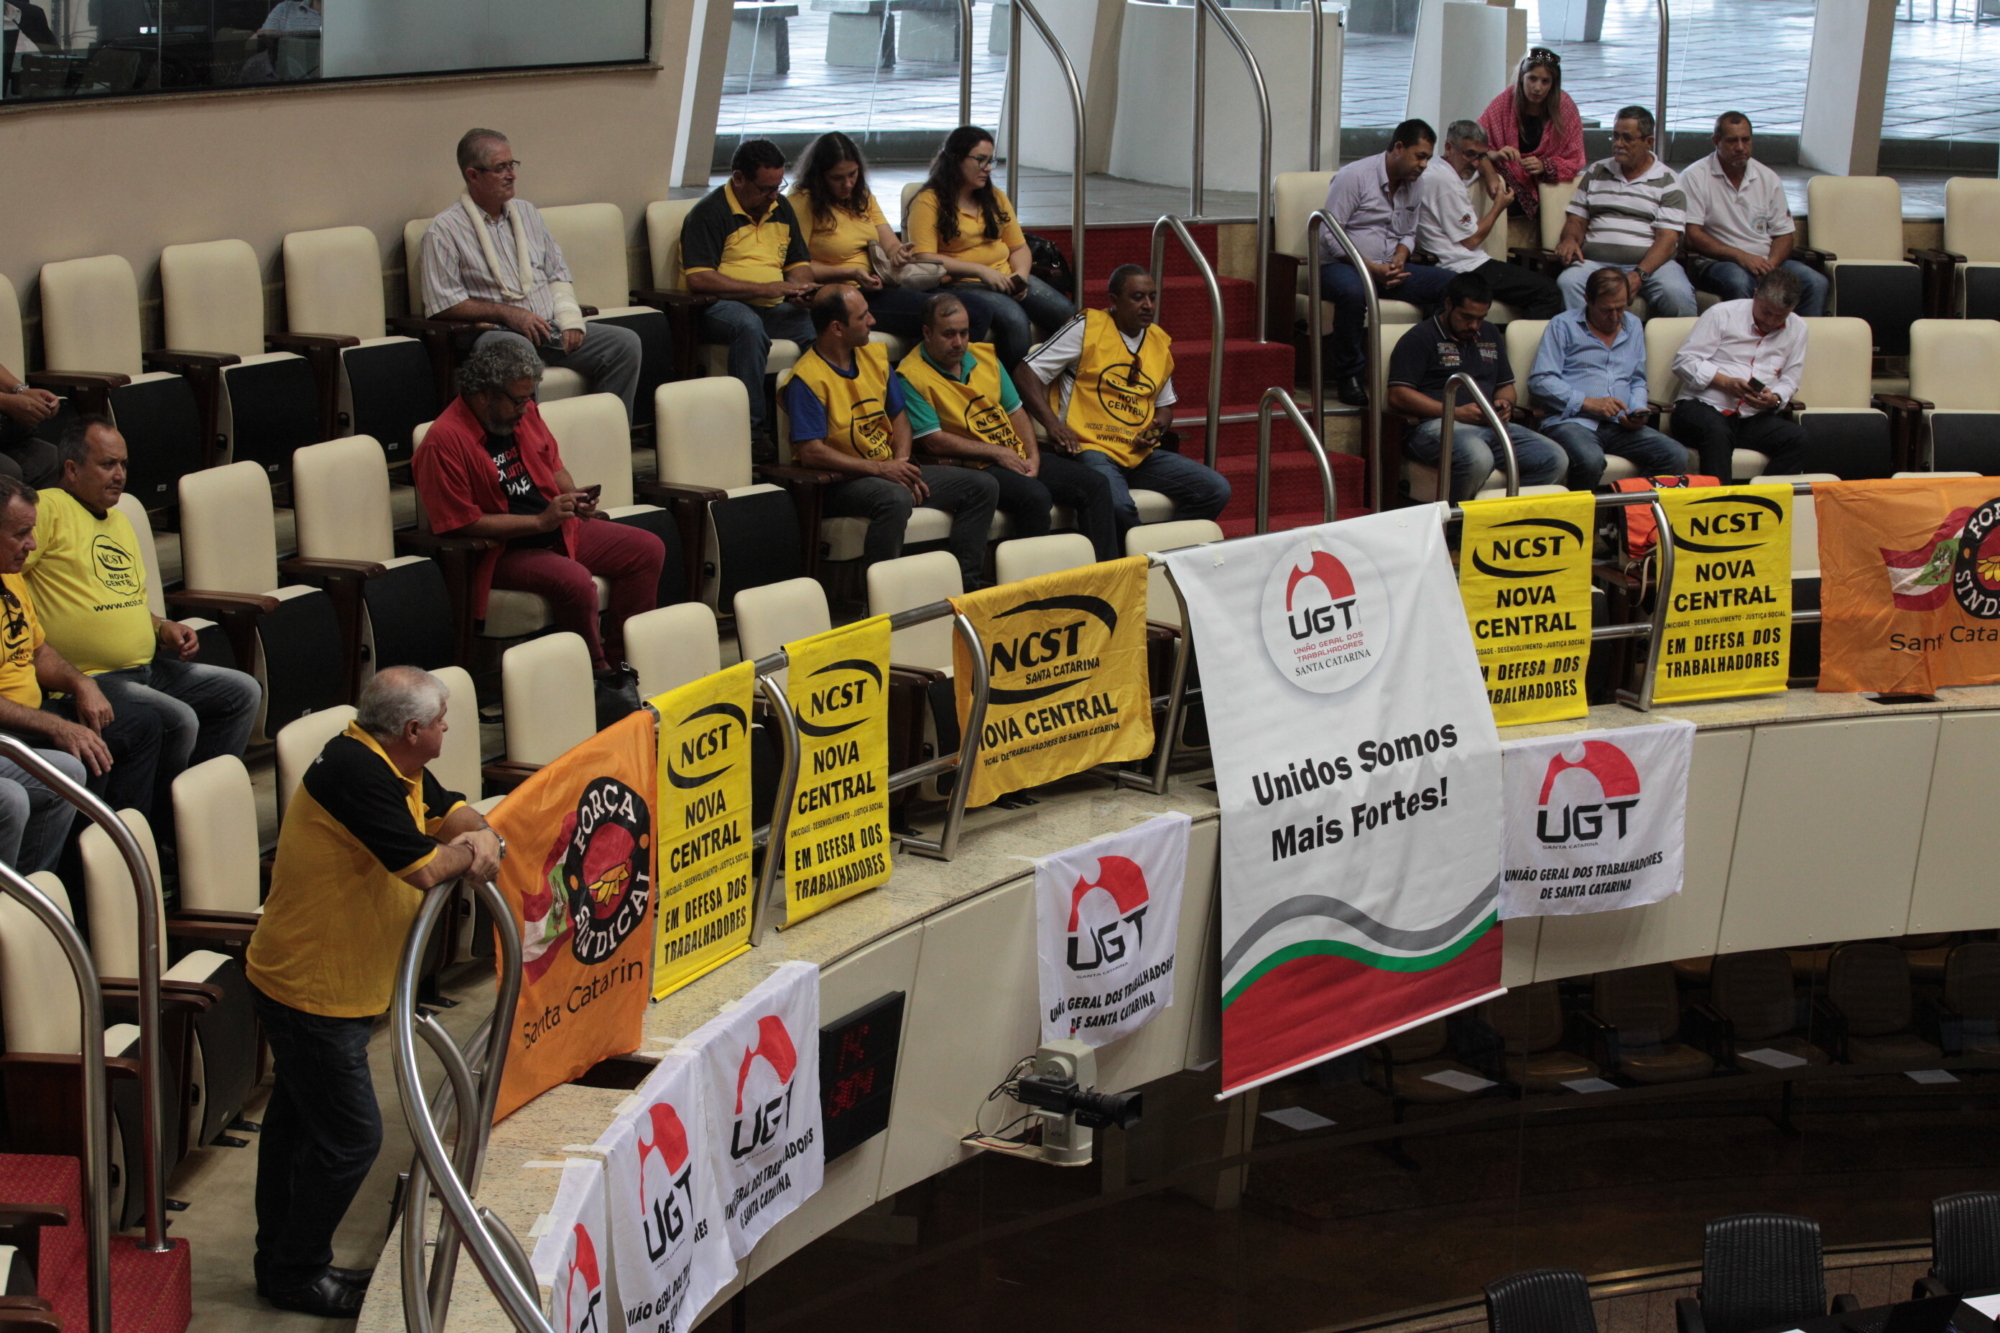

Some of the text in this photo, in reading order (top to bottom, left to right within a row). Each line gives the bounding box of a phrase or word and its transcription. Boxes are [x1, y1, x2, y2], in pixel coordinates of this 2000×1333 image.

[1107, 400, 1145, 418] CENTRAL
[1690, 511, 1764, 537] NCST
[1492, 535, 1566, 562] NCST
[1696, 559, 1756, 583] NOVA
[1496, 584, 1556, 609] NOVA
[1674, 585, 1777, 613] CENTRAL
[1288, 598, 1357, 640] UGT
[1475, 611, 1577, 640] CENTRAL
[1694, 614, 1742, 626] DESENVOLVIMENTO
[1745, 612, 1768, 621] JUSTIÇA
[1768, 610, 1786, 618] SOCIAL
[989, 620, 1086, 677] NCST
[1293, 631, 1364, 655] UNIÃO GERAL DOS
[1297, 639, 1364, 662] TRABALHADORES
[1498, 643, 1543, 654] DESENVOLVIMENTO
[1546, 640, 1567, 649] JUSTIÇA
[1568, 638, 1586, 646] SOCIAL
[1667, 627, 1781, 655] EM DEFESA DOS
[1025, 657, 1100, 685] SANTA CATARINA
[1295, 649, 1371, 677] SANTA CATARINA
[1497, 659, 1546, 681] DEFESA
[1552, 655, 1580, 674] DOS
[1666, 650, 1780, 679] TRABALHADORES
[811, 679, 867, 718] NCST
[1025, 692, 1119, 736] CENTRAL
[680, 723, 732, 769] NCST
[1059, 735, 1068, 744] DE
[1068, 731, 1089, 742] SANTA
[1089, 722, 1120, 736] CATARINA
[813, 740, 860, 775] NOVA
[1252, 723, 1458, 806] Unidos Somos
[685, 789, 726, 830] NOVA
[797, 771, 876, 815] CENTRAL
[574, 784, 637, 856] FORÇA
[1271, 776, 1448, 862] Mais Fortes!
[1537, 798, 1640, 843] UGT
[670, 820, 741, 874] CENTRAL
[795, 823, 883, 872] EM DEFESA DOS
[795, 852, 886, 902] TRABALHADORES
[1504, 851, 1663, 882] UNIÃO GERAL DOS TRABALHADORES
[665, 874, 747, 934] EM DEFESA DOS
[1540, 879, 1632, 900] DE SANTA CATARINA
[664, 905, 747, 965] TRABALHADORES
[1066, 905, 1149, 972] UGT
[1067, 995, 1102, 1011] GERAL
[1104, 988, 1123, 1007] DOS
[1071, 991, 1156, 1029] DE SANTA CATARINA
[523, 1003, 561, 1050] Santa
[730, 1077, 794, 1160] UGT
[642, 1162, 694, 1263] UGT
